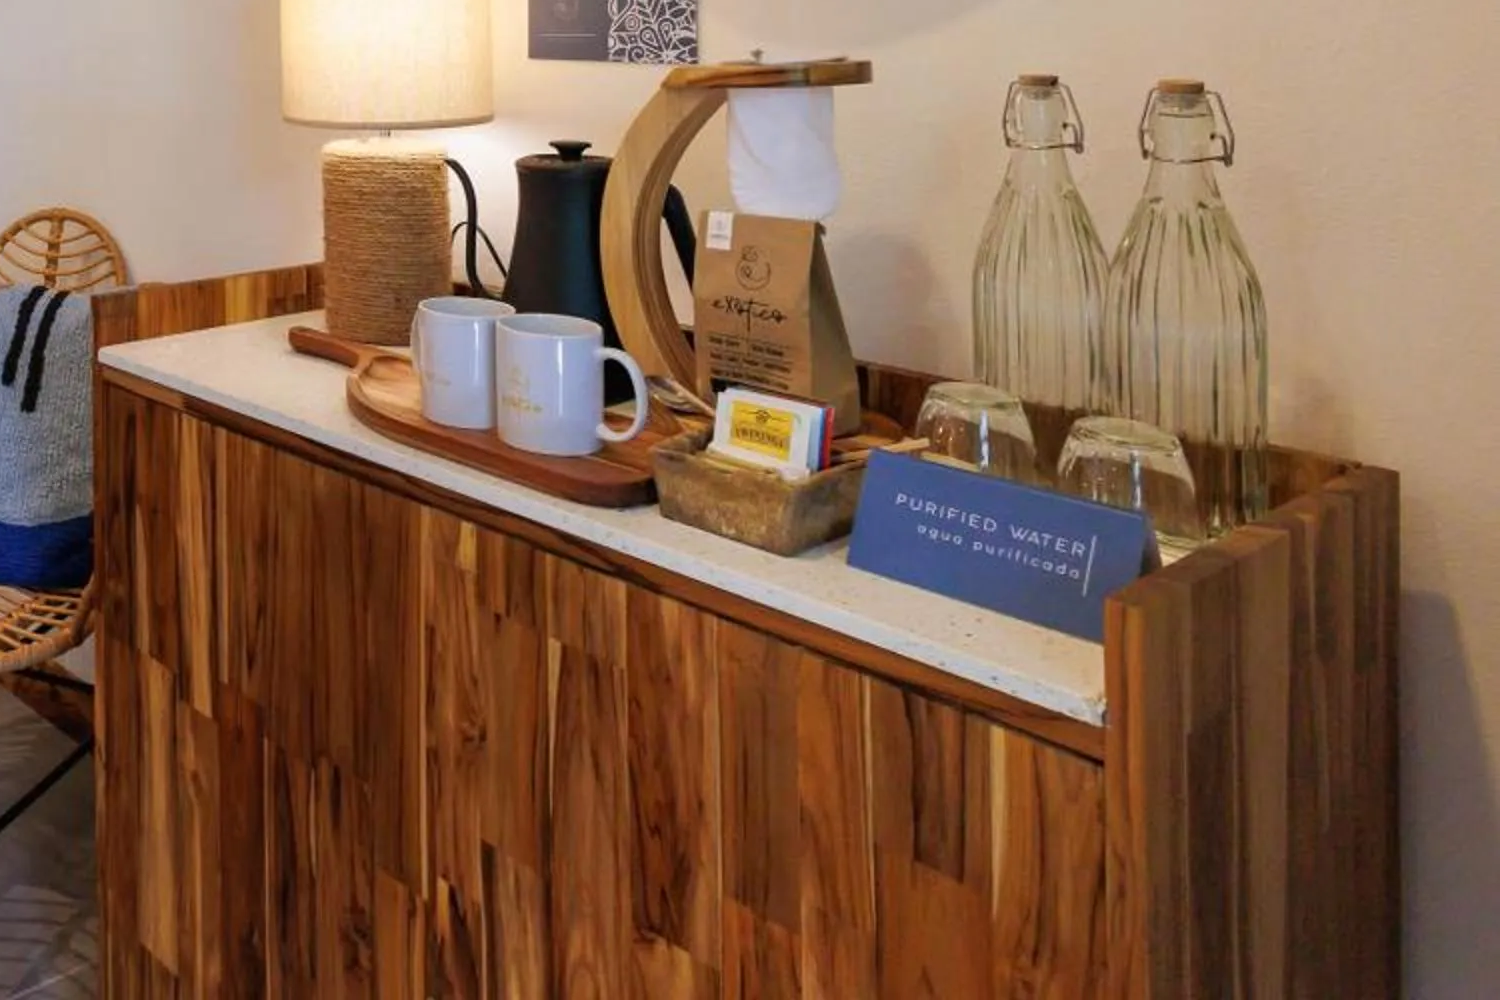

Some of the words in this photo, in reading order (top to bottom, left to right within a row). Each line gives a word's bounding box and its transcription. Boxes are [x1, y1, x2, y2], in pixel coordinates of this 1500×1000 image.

[895, 492, 998, 533] PURIFIED
[1009, 523, 1086, 557] WATER
[917, 524, 963, 546] agua
[972, 540, 1081, 580] purificada
